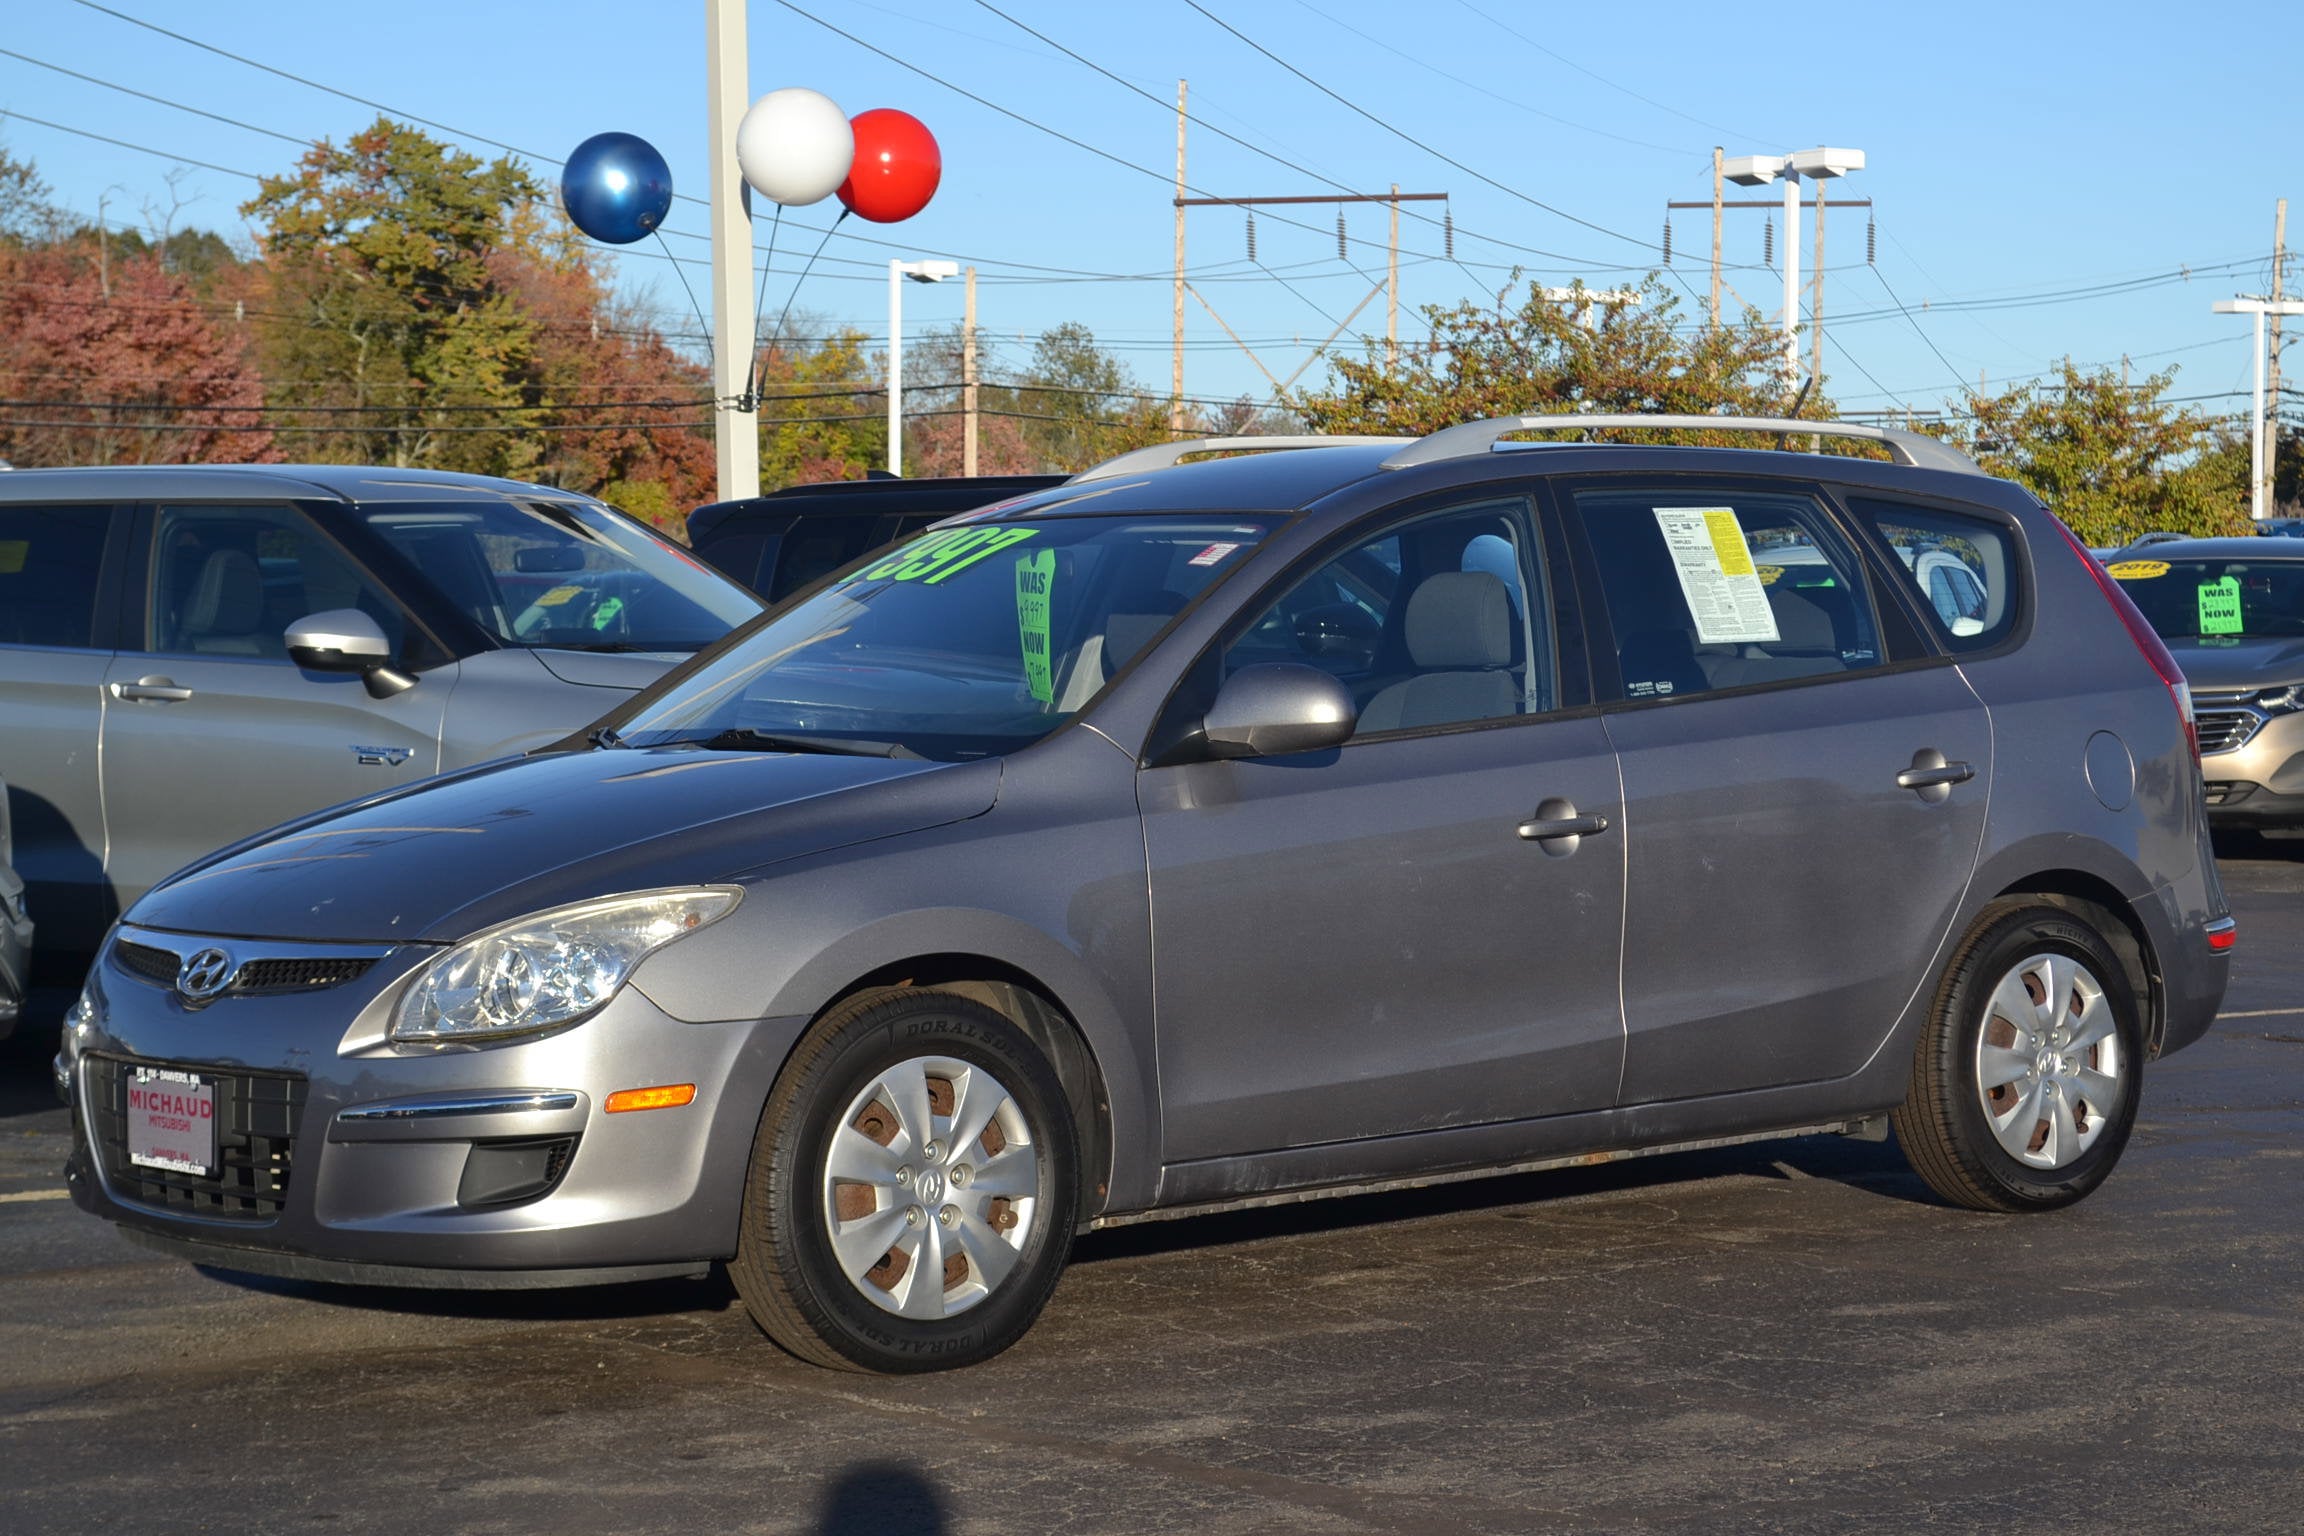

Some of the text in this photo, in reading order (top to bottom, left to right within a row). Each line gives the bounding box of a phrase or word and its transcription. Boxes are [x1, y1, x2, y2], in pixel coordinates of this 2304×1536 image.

[1020, 570, 1046, 595] WAS
[2204, 587, 2234, 598] WAS
[2204, 609, 2236, 619] NOW
[1023, 630, 1045, 655] NOW
[906, 1020, 977, 1038] DORAL
[129, 1089, 213, 1119] MICHAUD
[148, 1115, 192, 1132] MITSUBISHI
